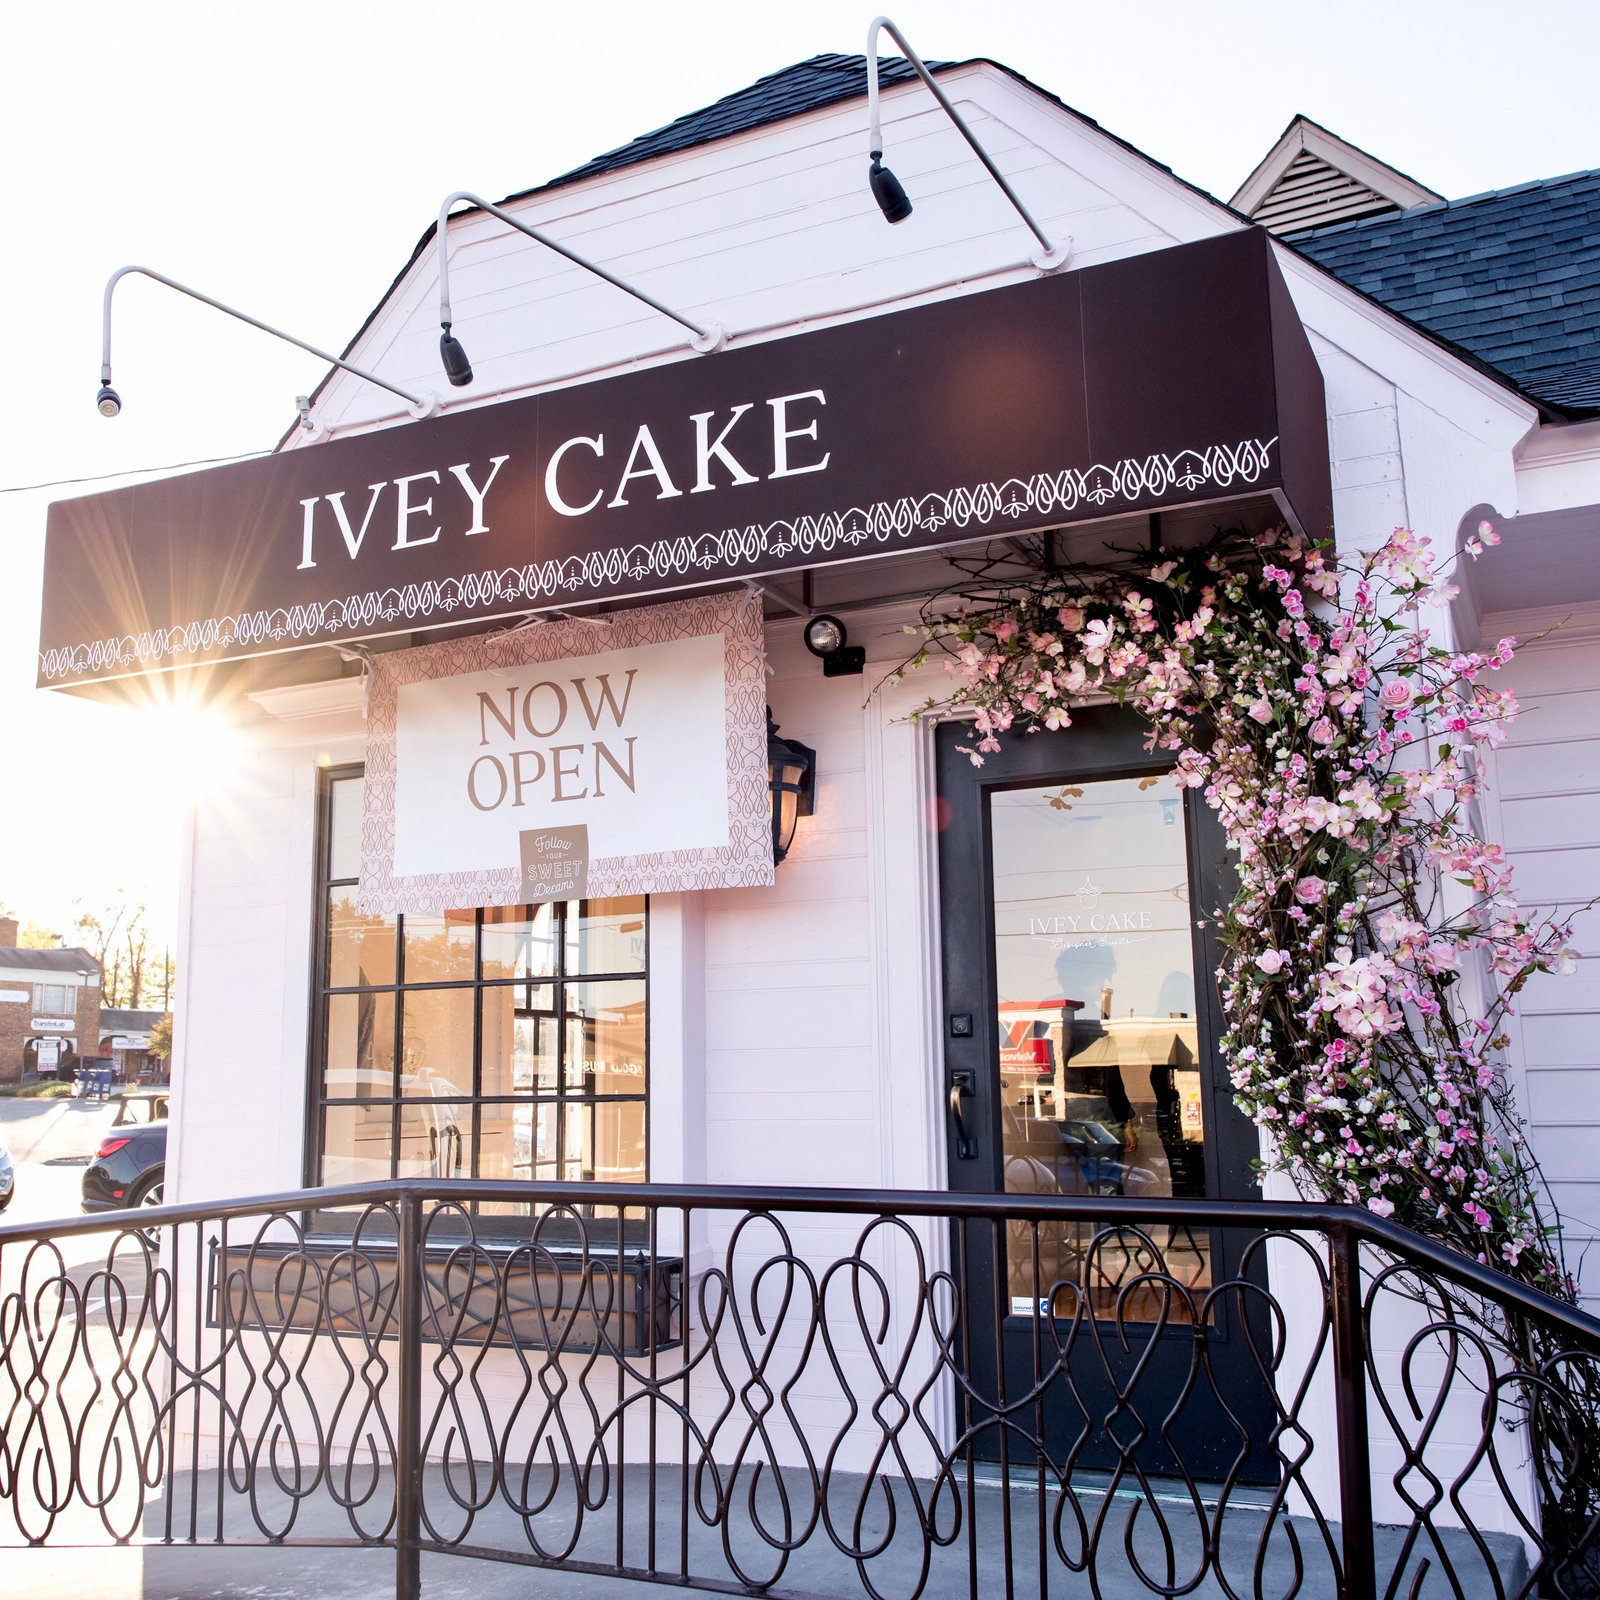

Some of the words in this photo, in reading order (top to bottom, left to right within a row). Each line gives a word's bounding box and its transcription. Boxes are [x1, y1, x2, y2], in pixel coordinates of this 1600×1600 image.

[296, 454, 510, 570] IVEY
[544, 388, 831, 517] CAKE
[476, 669, 638, 746] NOW
[467, 736, 638, 812] OPEN
[534, 834, 572, 853] Follow
[546, 852, 563, 860] YOUR
[527, 860, 583, 881] SWEET
[533, 880, 574, 898] Dreams
[1029, 915, 1081, 935] IVEY
[1090, 911, 1153, 931] CAKE
[1049, 937, 1096, 950] Designer
